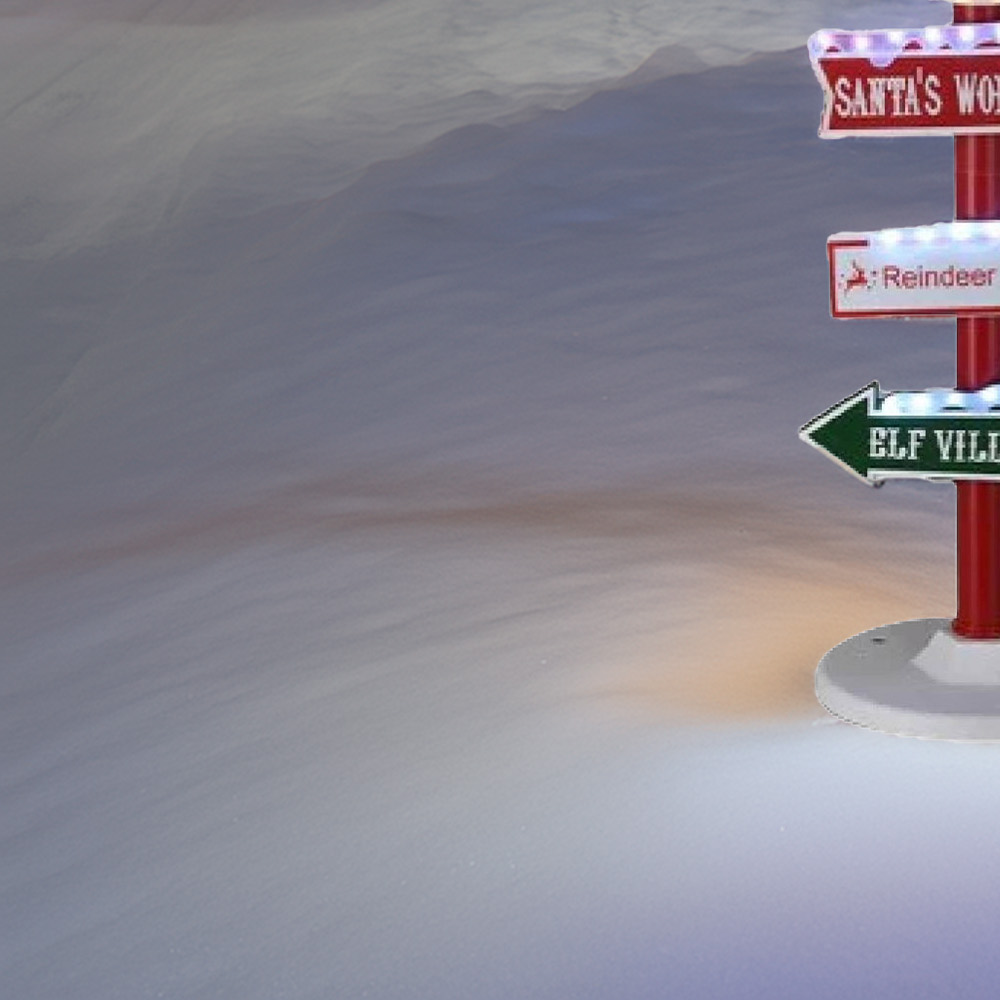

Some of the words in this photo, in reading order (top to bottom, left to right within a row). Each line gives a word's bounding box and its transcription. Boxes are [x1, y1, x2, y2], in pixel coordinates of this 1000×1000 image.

[834, 67, 941, 117] SANTA'S
[882, 264, 996, 289] Reindeer
[868, 427, 926, 460] ELF
